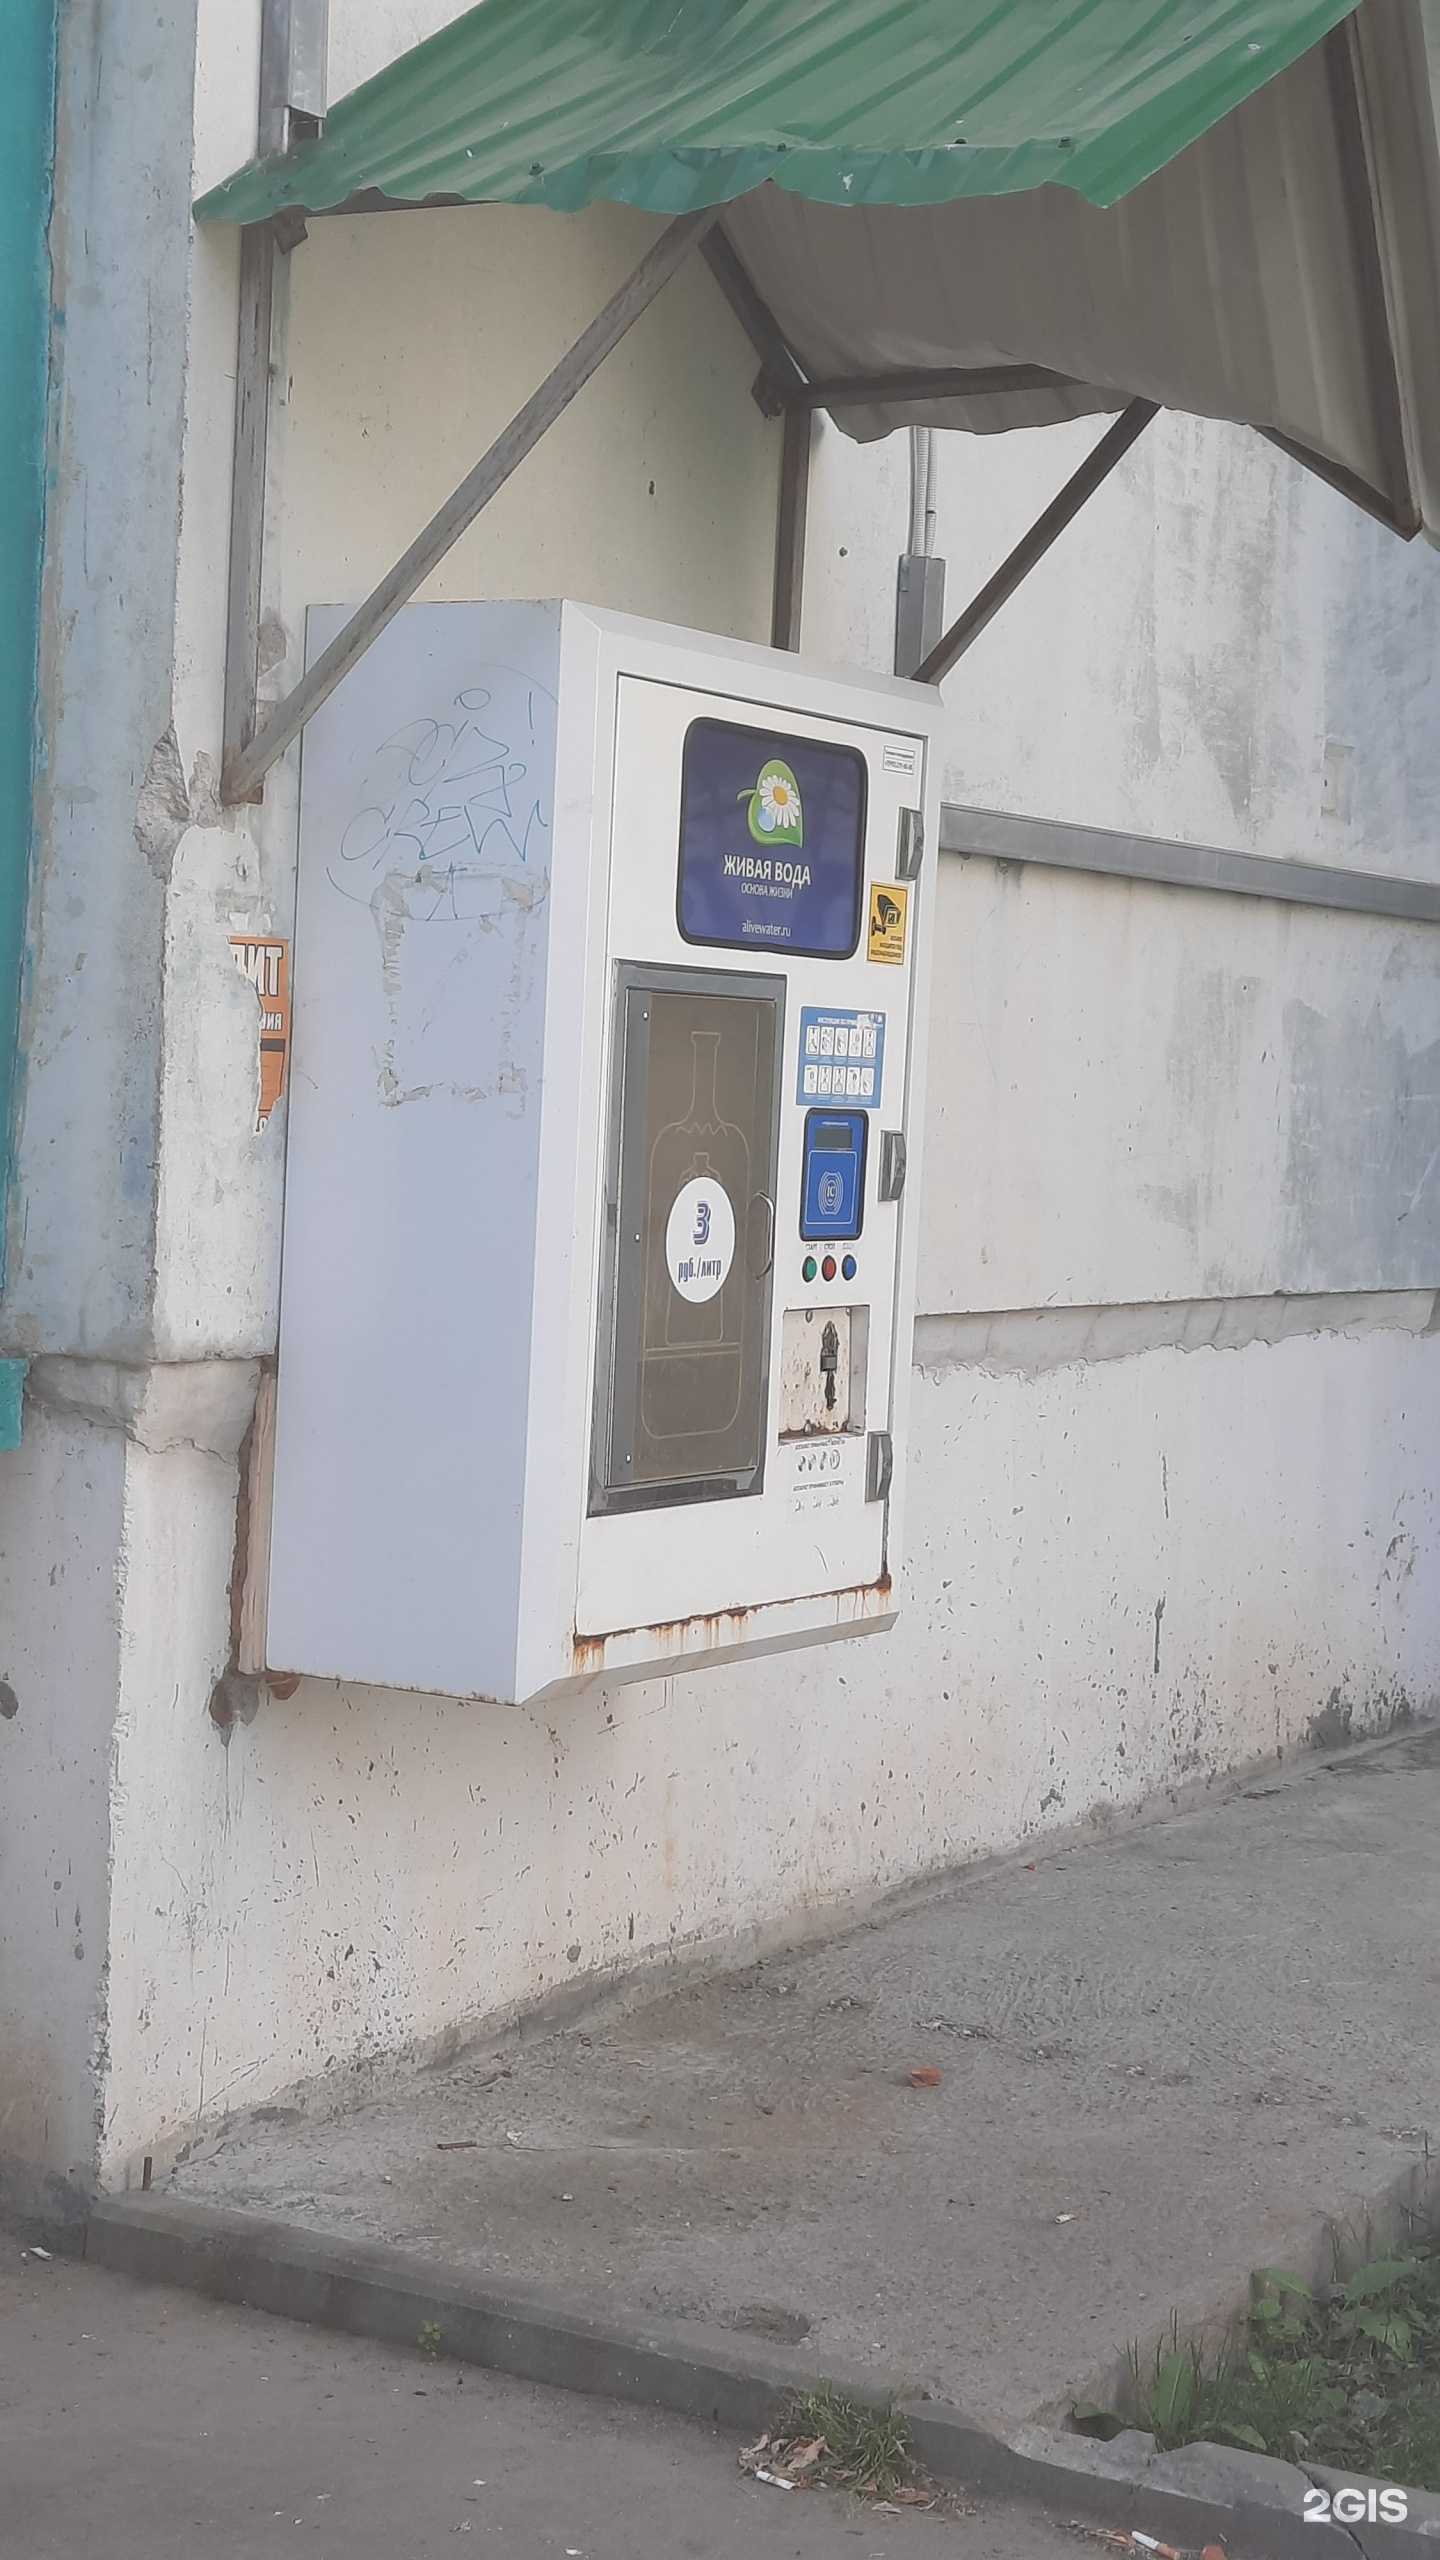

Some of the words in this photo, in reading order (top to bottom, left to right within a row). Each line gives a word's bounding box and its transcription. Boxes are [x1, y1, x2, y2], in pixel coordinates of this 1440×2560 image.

[723, 854, 772, 881] ЖИВАЯ
[774, 861, 812, 891] ВОДА
[741, 882, 769, 897] ОСНОВА
[769, 886, 793, 900] ЖИЗНИ
[742, 919, 792, 938] alivewater.ru
[692, 1202, 712, 1246] 3
[678, 1255, 722, 1284] руб./литр
